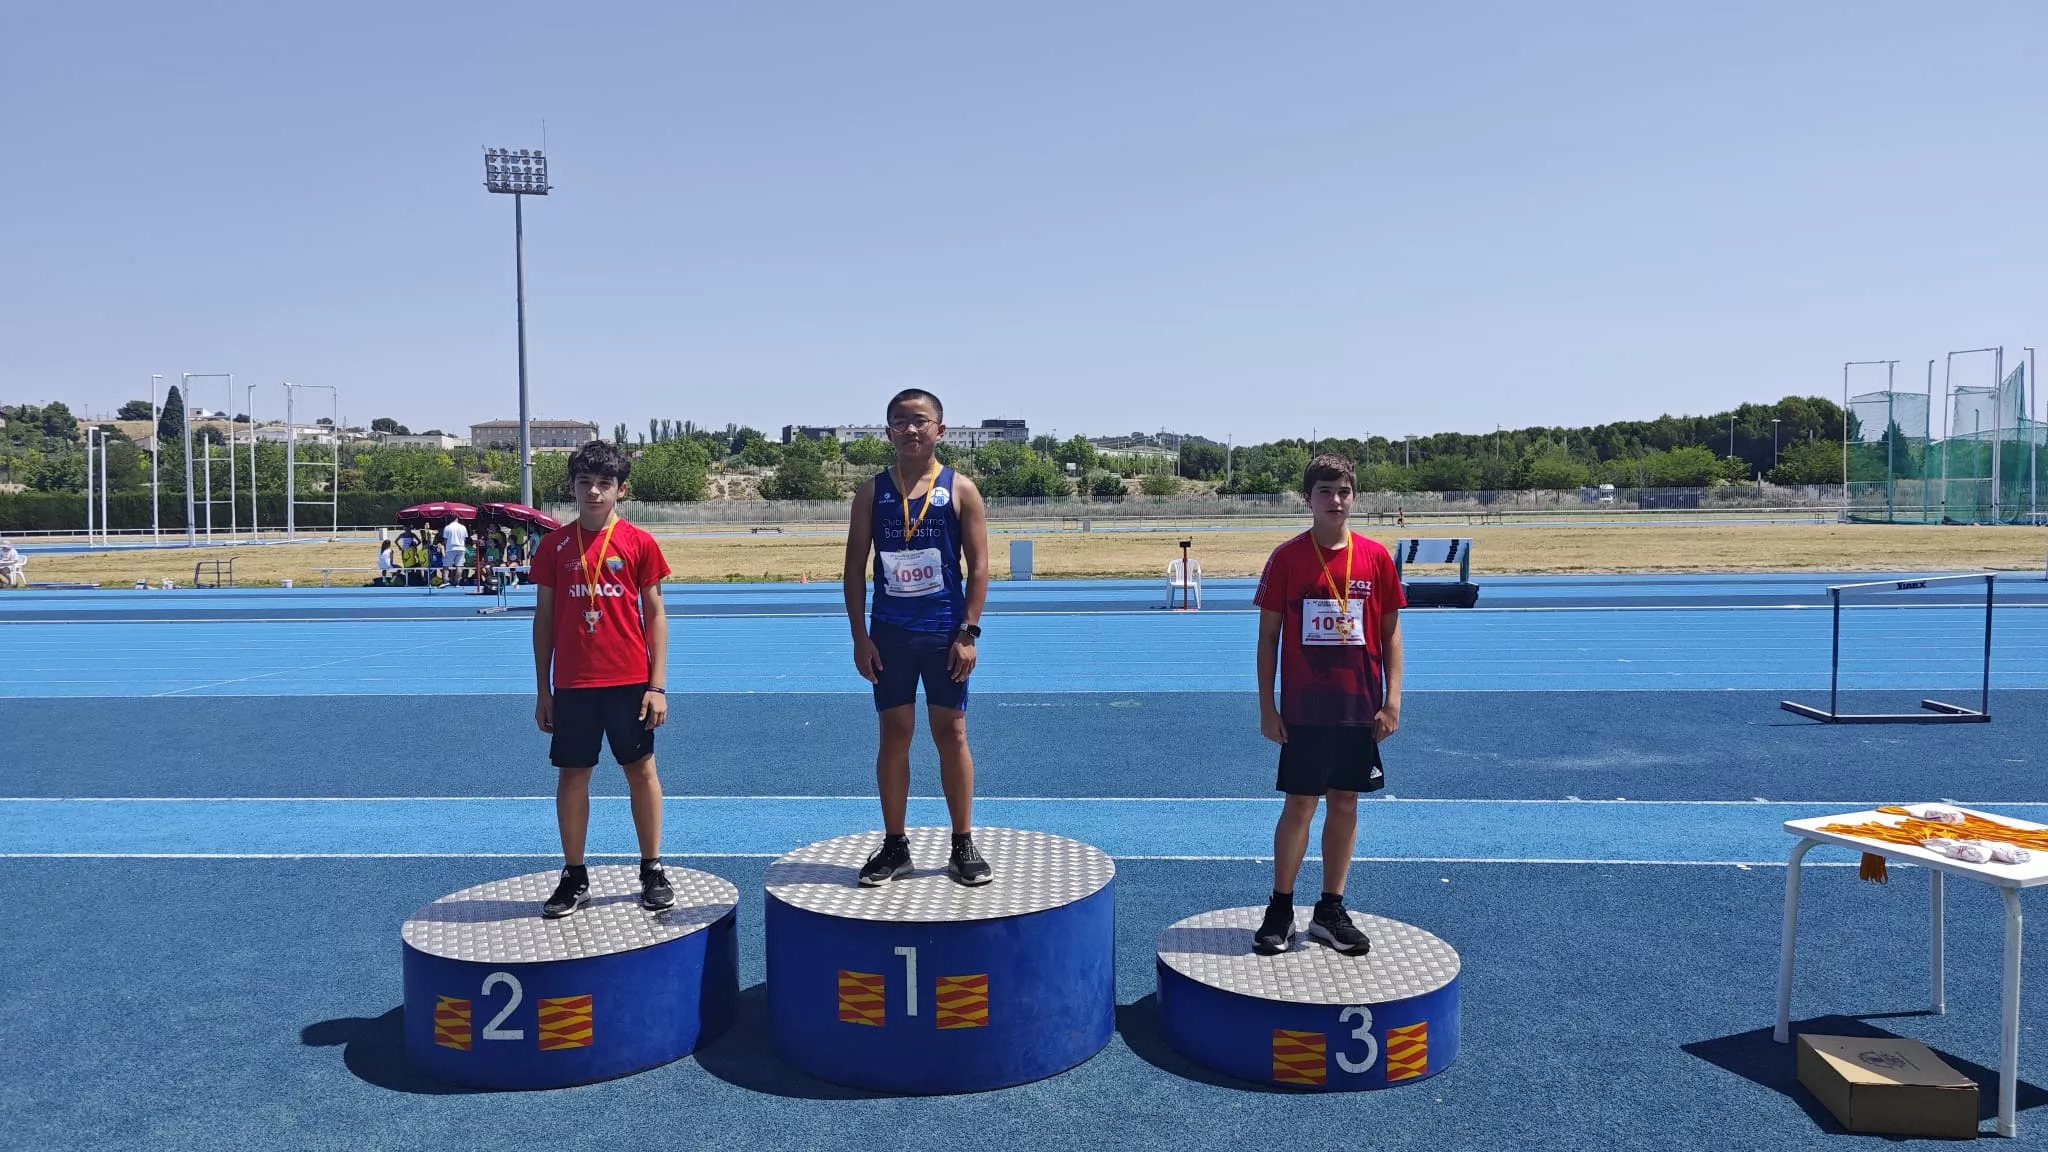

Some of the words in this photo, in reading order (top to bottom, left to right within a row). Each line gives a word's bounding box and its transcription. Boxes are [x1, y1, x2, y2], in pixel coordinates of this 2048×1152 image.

[882, 518, 901, 527] Club
[884, 526, 941, 539] Barastro
[892, 565, 934, 583] 1090
[568, 583, 625, 597] SINACO
[1348, 580, 1372, 590] ZGZ
[894, 946, 918, 1016] 1
[481, 971, 524, 1040] 2
[1335, 1005, 1378, 1074] 3
